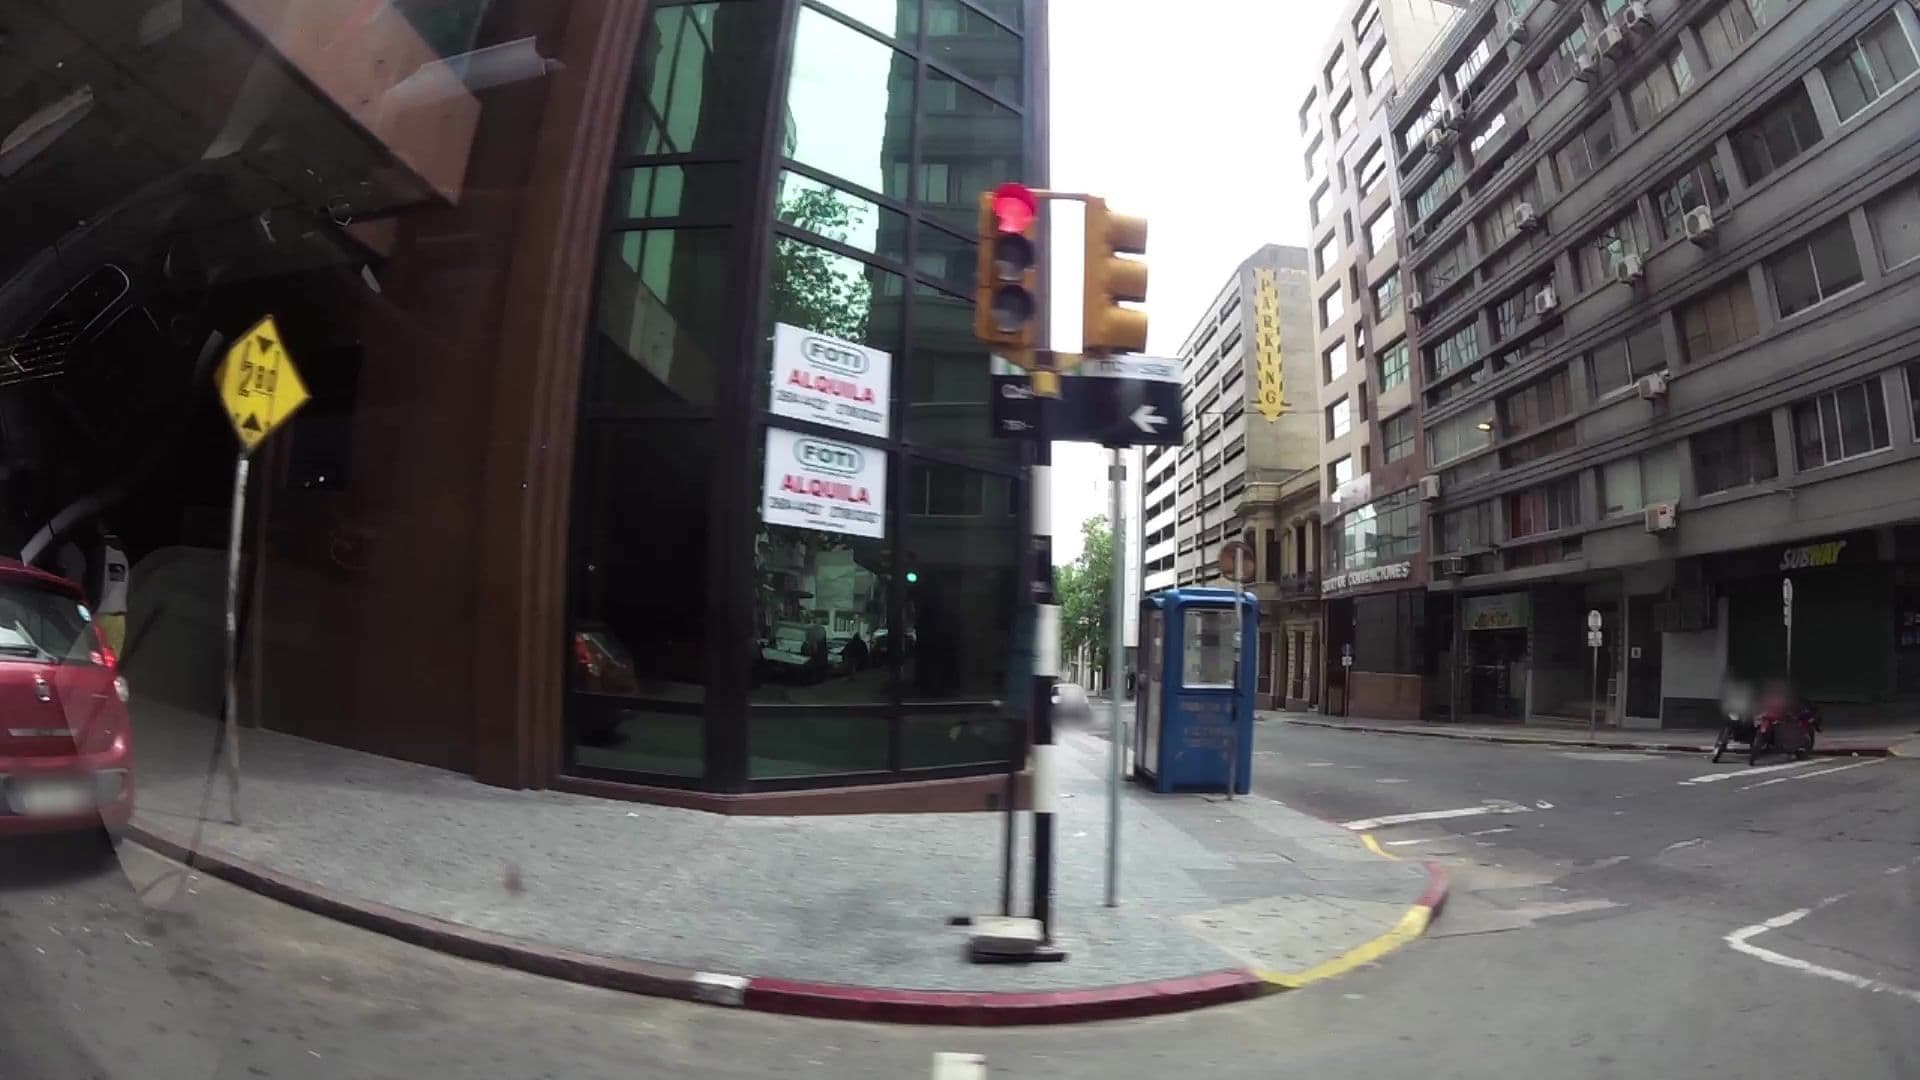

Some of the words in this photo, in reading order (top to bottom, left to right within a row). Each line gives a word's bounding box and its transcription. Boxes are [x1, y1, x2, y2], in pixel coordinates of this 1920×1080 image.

[1260, 278, 1278, 404] PARKING
[810, 343, 862, 369] FOTI
[789, 369, 875, 403] ALQUILA
[803, 444, 856, 469] FOTI
[782, 474, 870, 504] ALQUILA
[1780, 541, 1847, 570] SUBWAY
